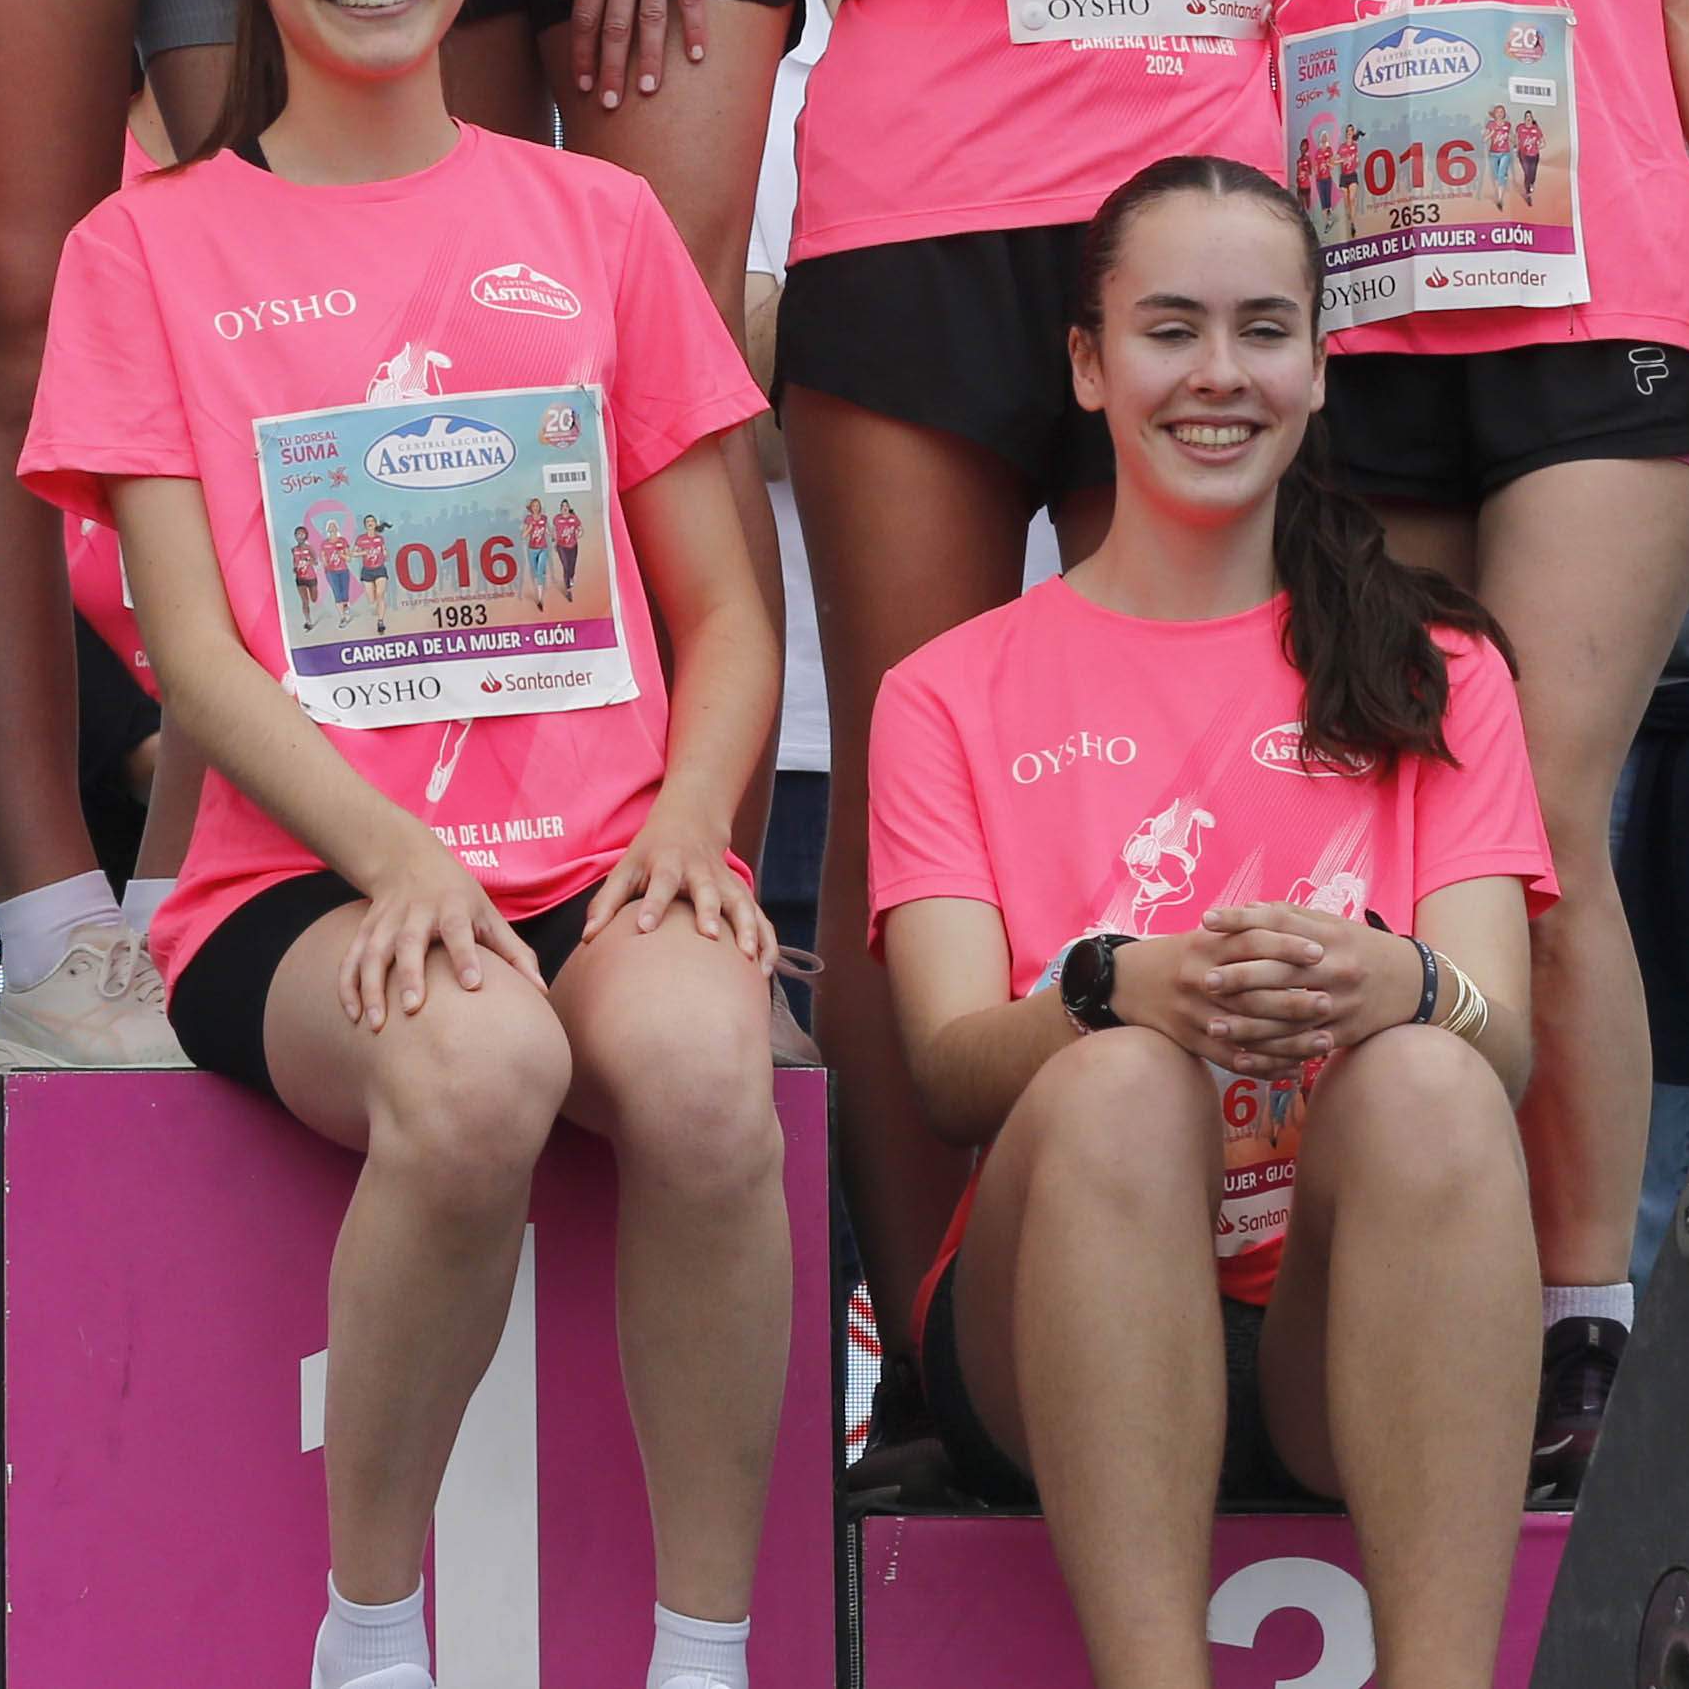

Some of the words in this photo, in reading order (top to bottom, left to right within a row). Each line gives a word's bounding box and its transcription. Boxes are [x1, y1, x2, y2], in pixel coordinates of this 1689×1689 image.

[1071, 36, 1146, 52] CARRERA
[1150, 36, 1168, 53] DE
[1171, 36, 1190, 53] LA
[1193, 37, 1238, 55] MUJER
[1417, 44, 1465, 56] LECHERA
[1510, 27, 1538, 48] 20
[1146, 54, 1183, 76] 2024
[1298, 54, 1309, 64] TU
[1309, 48, 1338, 62] DORSAL
[1298, 60, 1337, 83] SUMA
[1360, 56, 1471, 88] ASTURIANA
[1364, 140, 1477, 196] 016
[1389, 204, 1441, 230] 2653
[1325, 245, 1380, 268] CARRERA
[1382, 239, 1399, 255] DE
[1402, 235, 1416, 251] LA
[1421, 229, 1477, 248] MUJER
[1491, 224, 1533, 245] GIJÓN
[483, 281, 575, 313] ASTURIANA
[1321, 275, 1396, 311] OYSHO
[1453, 269, 1548, 287] Santander
[214, 289, 357, 341] OYSHO
[546, 409, 574, 431] 20
[278, 437, 292, 447] TU
[295, 431, 337, 445] DORSAL
[398, 439, 447, 452] CENTRAL
[449, 434, 500, 447] LECHERA
[281, 443, 339, 466] SUMA
[377, 446, 507, 477] ASTURIANA
[280, 470, 324, 494] gijón
[395, 535, 518, 593] 016
[432, 604, 488, 629] 1983
[340, 640, 420, 666] CARRERA
[422, 637, 443, 655] DE
[446, 635, 467, 653] LA
[470, 632, 522, 651] MUJER
[534, 624, 575, 647] GIJÓN
[332, 676, 442, 709] OYSHO
[505, 670, 593, 693] Santander
[1012, 731, 1137, 785] OYSHO
[460, 824, 480, 846] DE
[482, 822, 503, 844] LA
[505, 816, 565, 842] MUJER
[461, 850, 500, 868] 2024
[1224, 1170, 1257, 1193] UJER
[1266, 1160, 1295, 1183] GIJÓ
[1238, 1207, 1289, 1234] Santan
